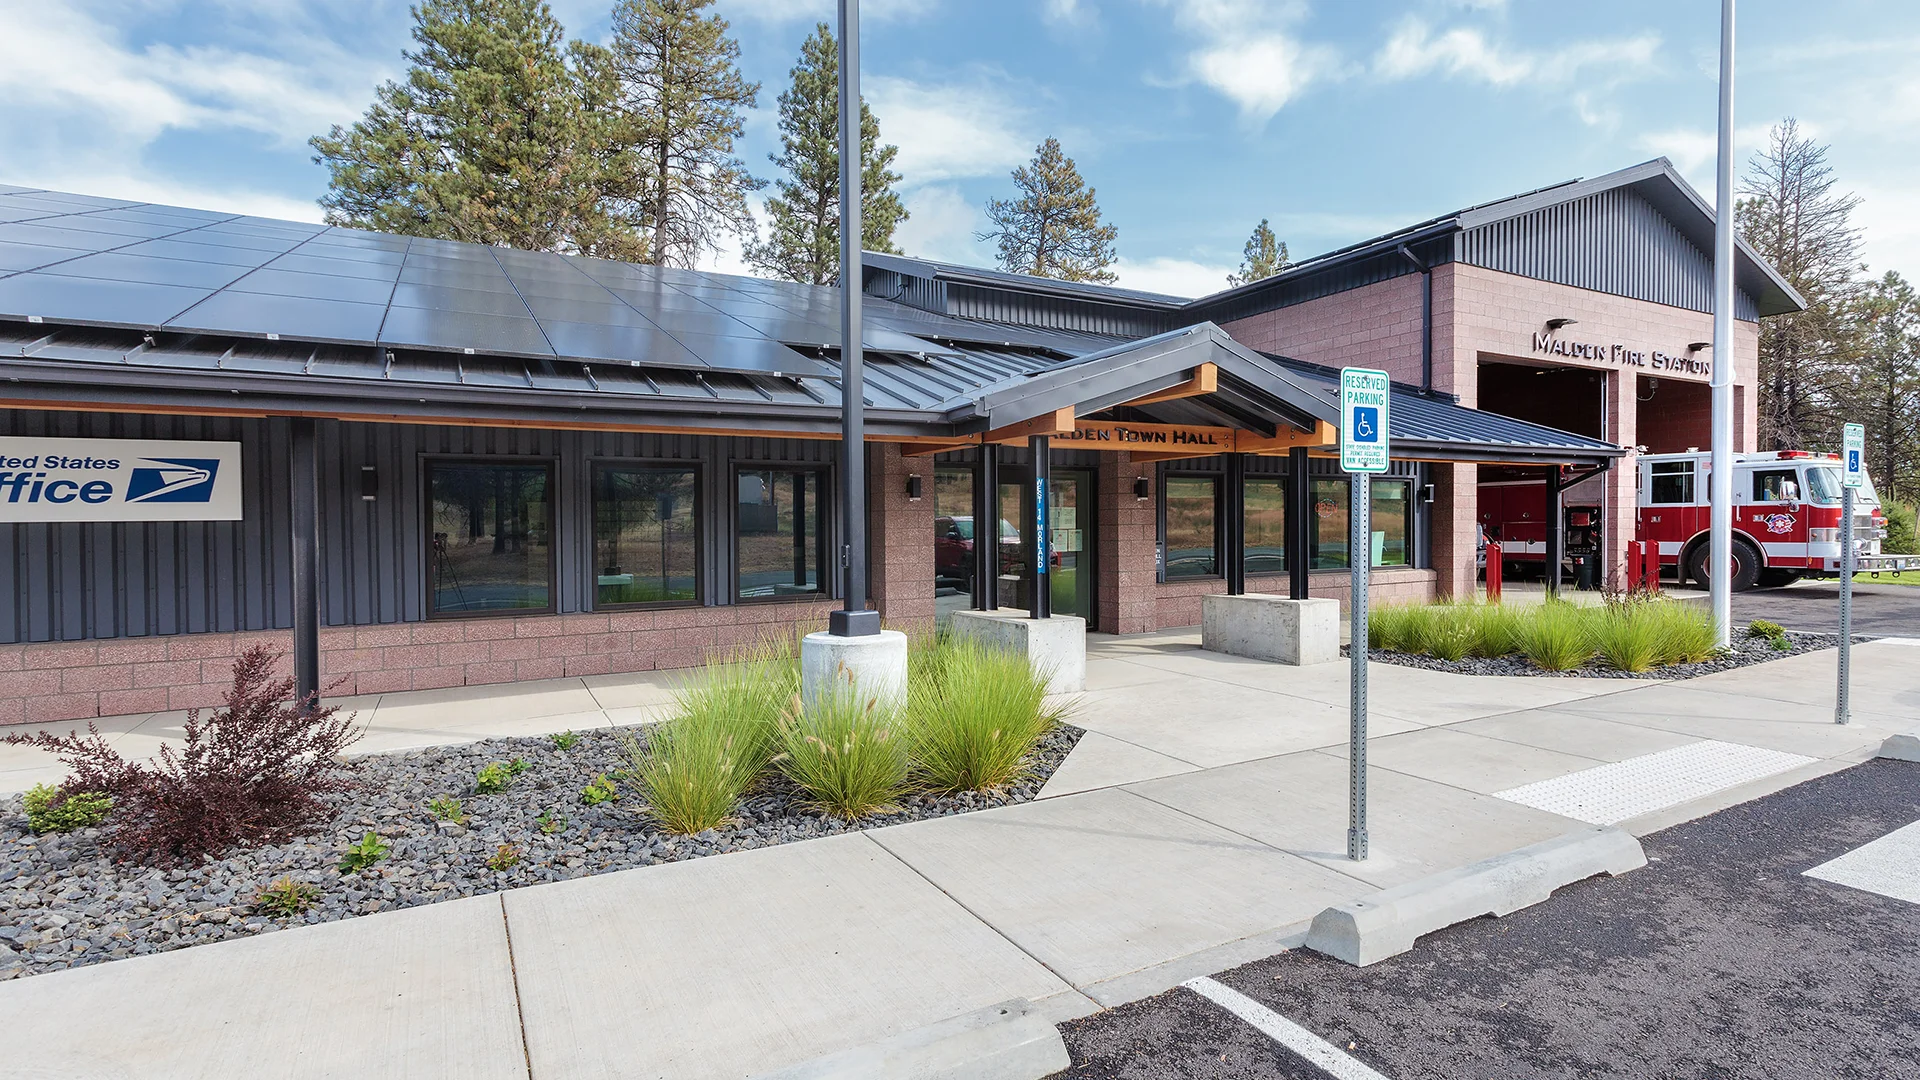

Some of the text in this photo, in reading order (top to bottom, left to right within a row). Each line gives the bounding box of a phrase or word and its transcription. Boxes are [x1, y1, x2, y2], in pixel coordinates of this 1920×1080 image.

[1533, 331, 1712, 376] MALDEN FIRE STATION
[1345, 375, 1386, 391] RESERVED
[1347, 391, 1385, 406] PARKING
[1114, 427, 1167, 443] TOWN
[1172, 430, 1218, 445] HALL
[43, 455, 121, 470] States
[1314, 502, 1339, 514] OPEN
